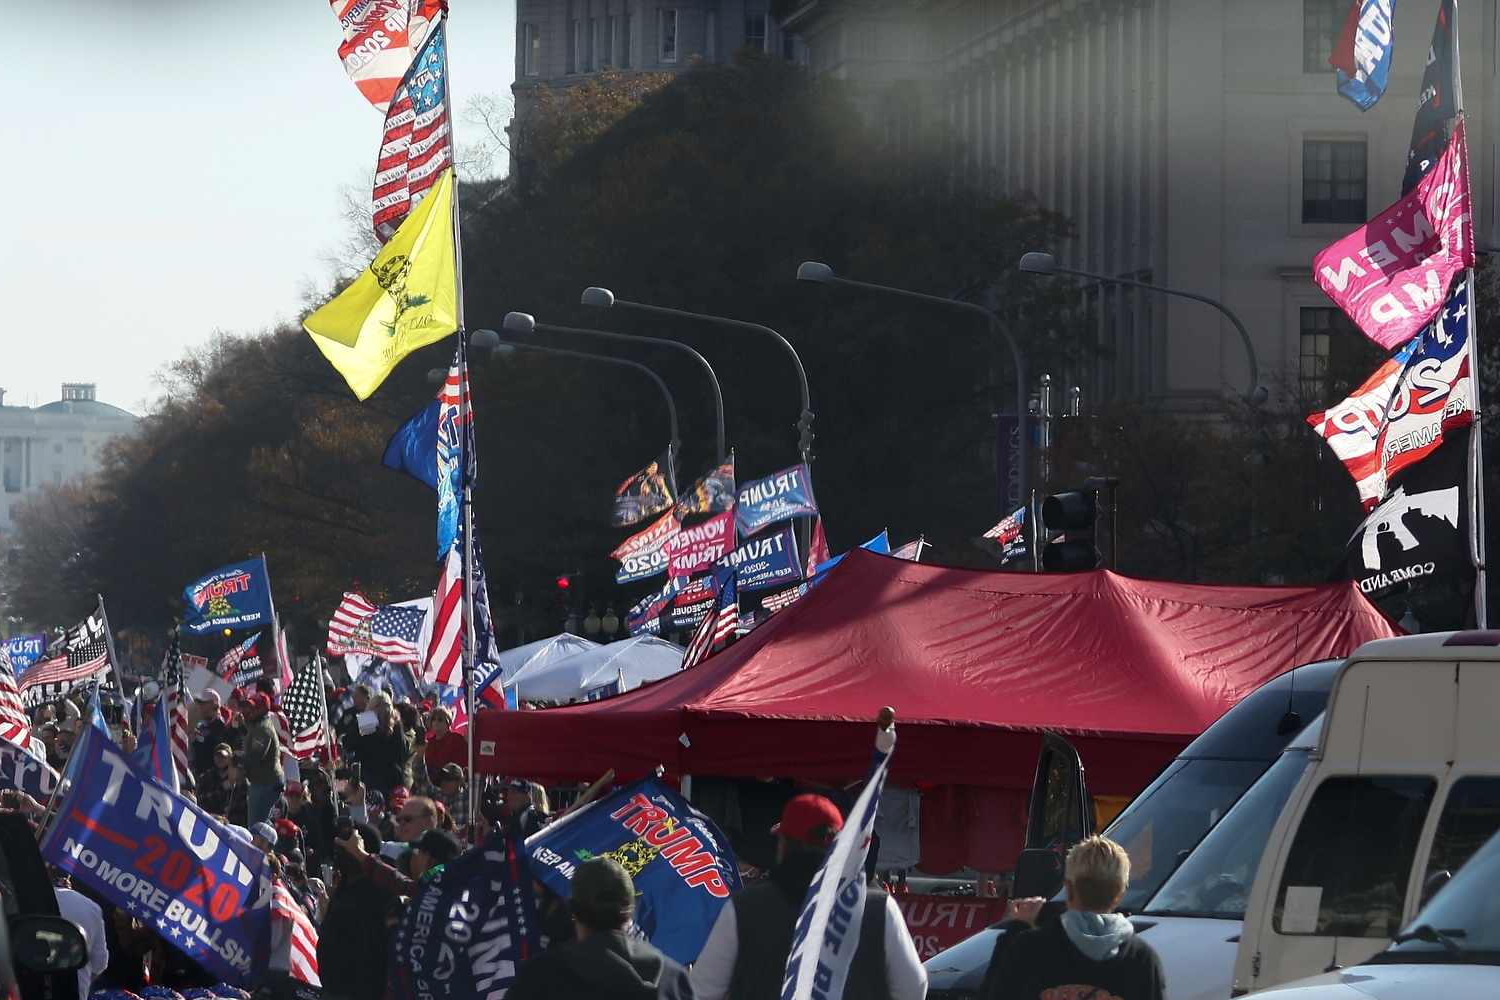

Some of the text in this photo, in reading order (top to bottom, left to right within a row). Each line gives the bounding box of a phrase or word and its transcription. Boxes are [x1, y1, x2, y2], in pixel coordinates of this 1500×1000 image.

[62, 837, 98, 869] NO
[100, 859, 170, 912] MORE
[132, 836, 241, 922] 2020
[532, 846, 563, 867] KEEP
[611, 793, 730, 898] TRUMP
[410, 884, 443, 973] AMERICA
